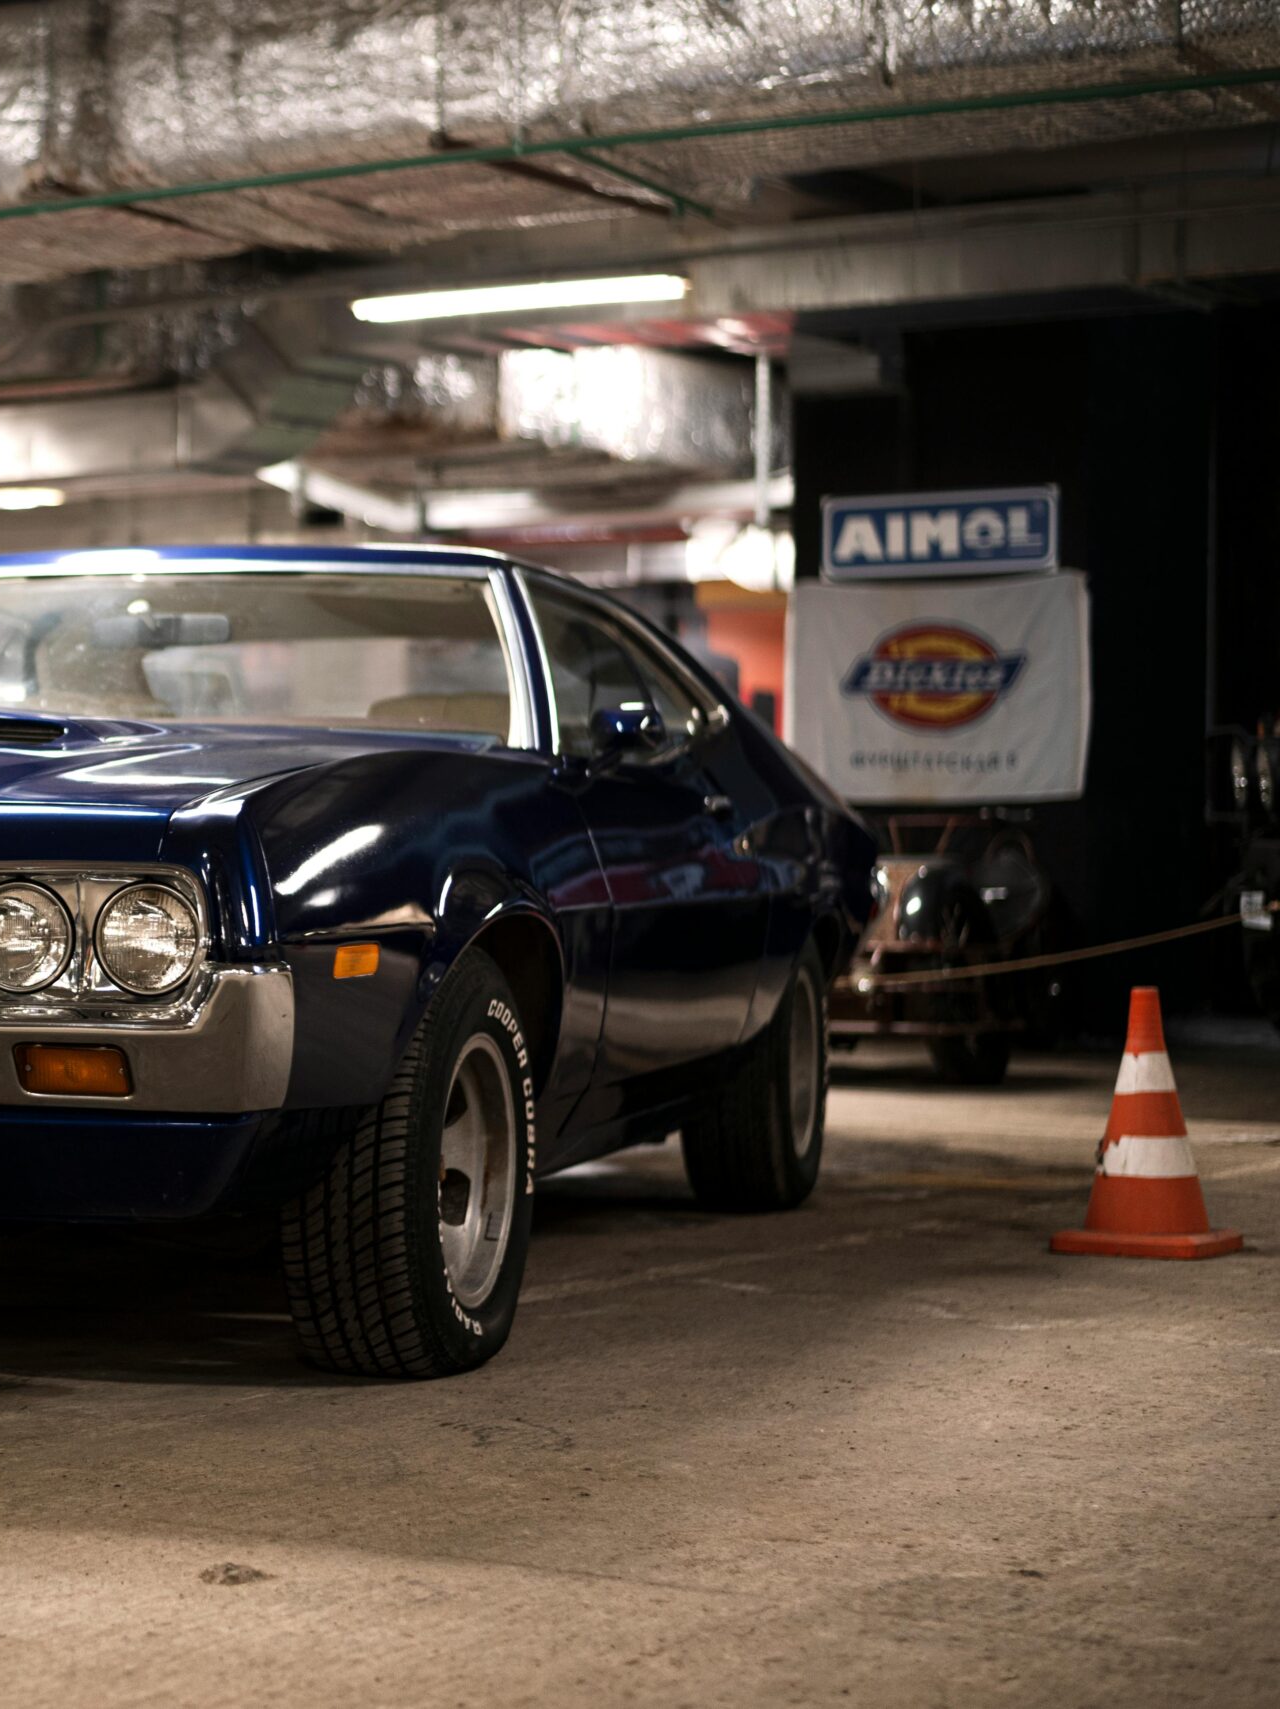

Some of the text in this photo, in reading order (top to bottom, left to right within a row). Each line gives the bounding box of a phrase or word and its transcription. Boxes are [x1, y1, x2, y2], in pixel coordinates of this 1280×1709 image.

[833, 505, 1043, 563] AIMOL
[486, 998, 536, 1195] COOPER COBRA
